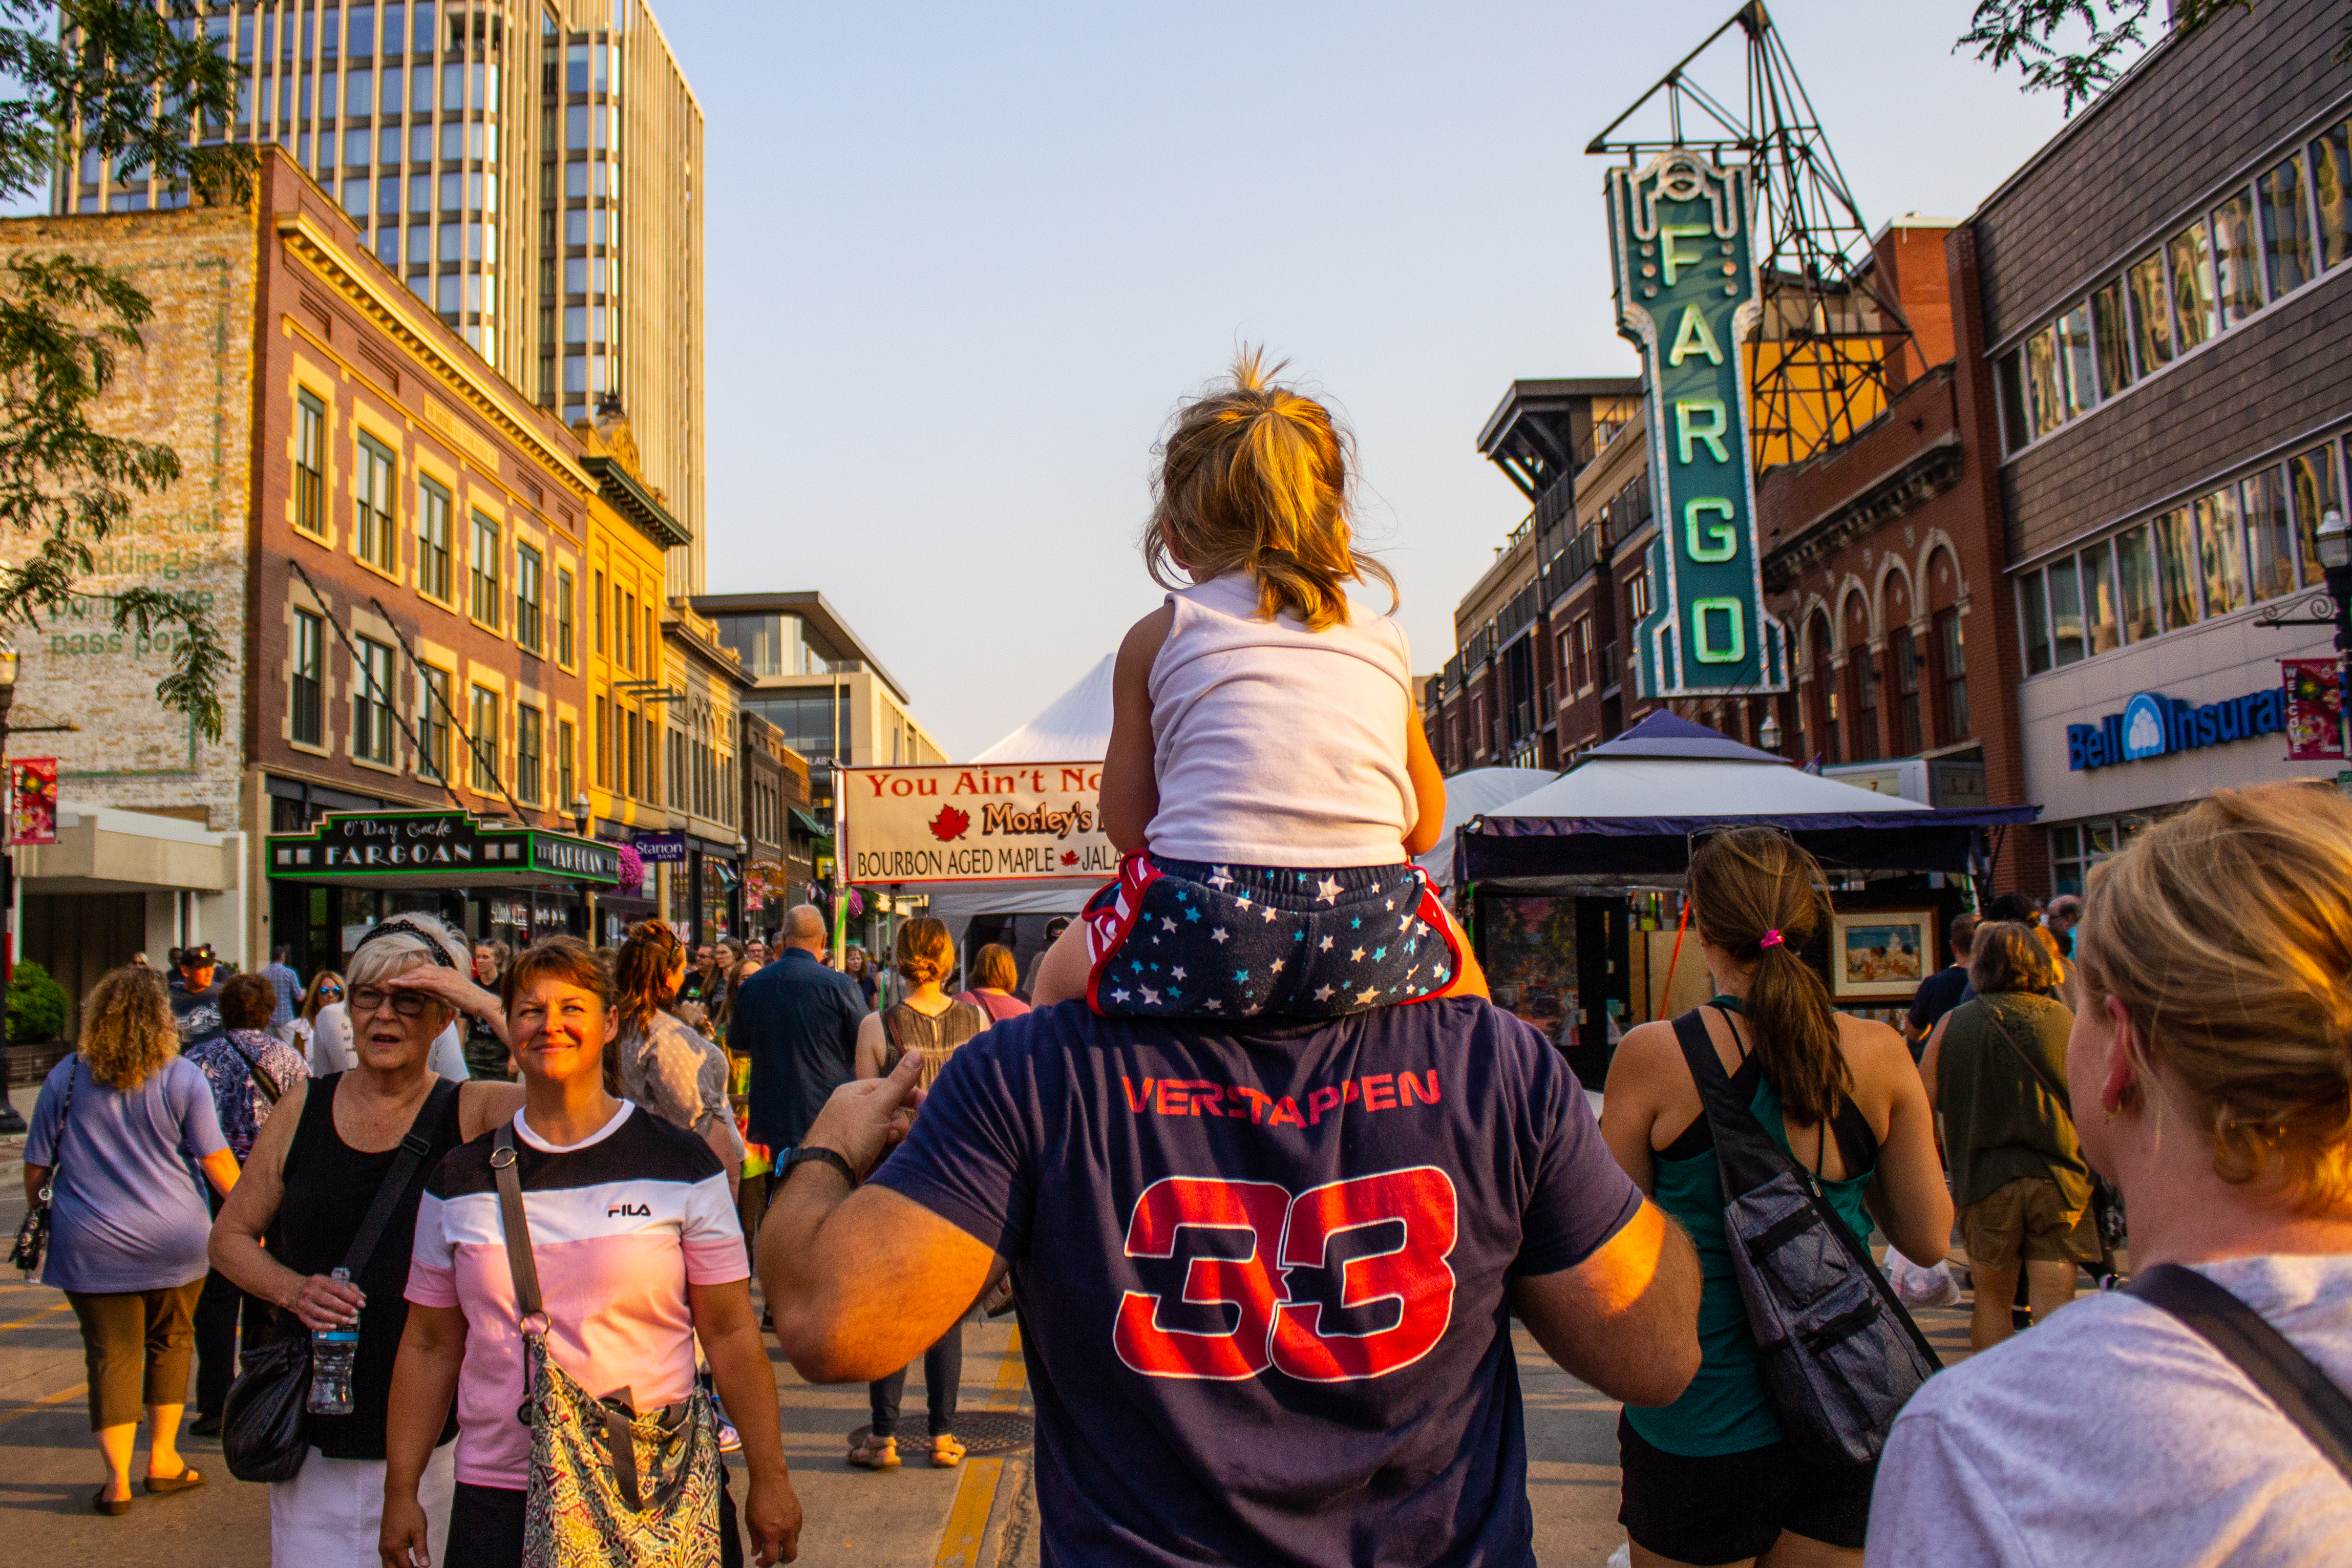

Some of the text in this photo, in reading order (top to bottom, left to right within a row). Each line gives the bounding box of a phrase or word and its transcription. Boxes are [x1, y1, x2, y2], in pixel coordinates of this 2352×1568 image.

[1660, 224, 1745, 664] FARGO
[51, 630, 186, 664] pass por
[2284, 667, 2302, 753] WELCOME
[2066, 714, 2120, 771] Bell
[866, 773, 938, 797] You
[952, 769, 1046, 796] Ain't
[13, 765, 24, 838] WELCOME
[982, 801, 1093, 840] Morley's
[324, 843, 472, 865] FARGOAN
[552, 843, 602, 873] FARGOAN
[635, 842, 683, 855] Starion
[857, 850, 943, 877] BOURBON
[948, 849, 993, 875] AGED
[998, 847, 1055, 873] MAPLE
[1121, 1069, 1442, 1129] VERSTAPPEN
[607, 1203, 651, 1218] FILA
[1113, 1166, 1458, 1383] 33
